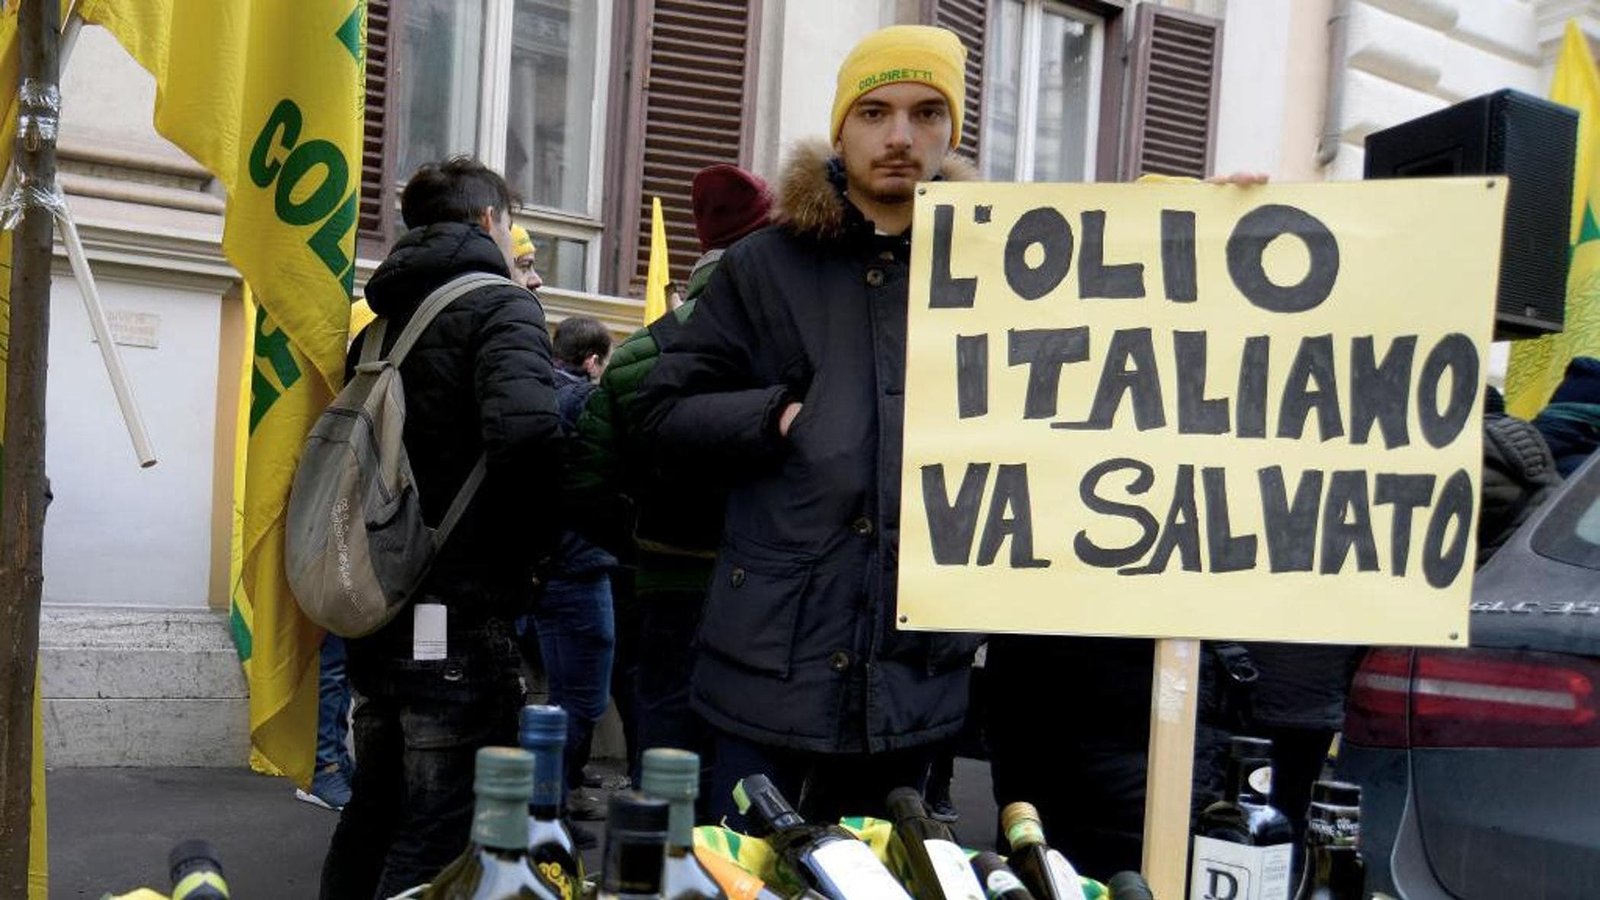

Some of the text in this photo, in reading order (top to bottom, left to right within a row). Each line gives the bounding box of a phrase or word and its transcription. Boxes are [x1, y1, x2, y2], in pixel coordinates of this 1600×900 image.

[858, 68, 932, 90] COLDIRETTI
[928, 203, 1340, 313] L'OLIO
[956, 326, 1480, 449] ITALIANO
[920, 457, 1473, 589] VA SALVATO
